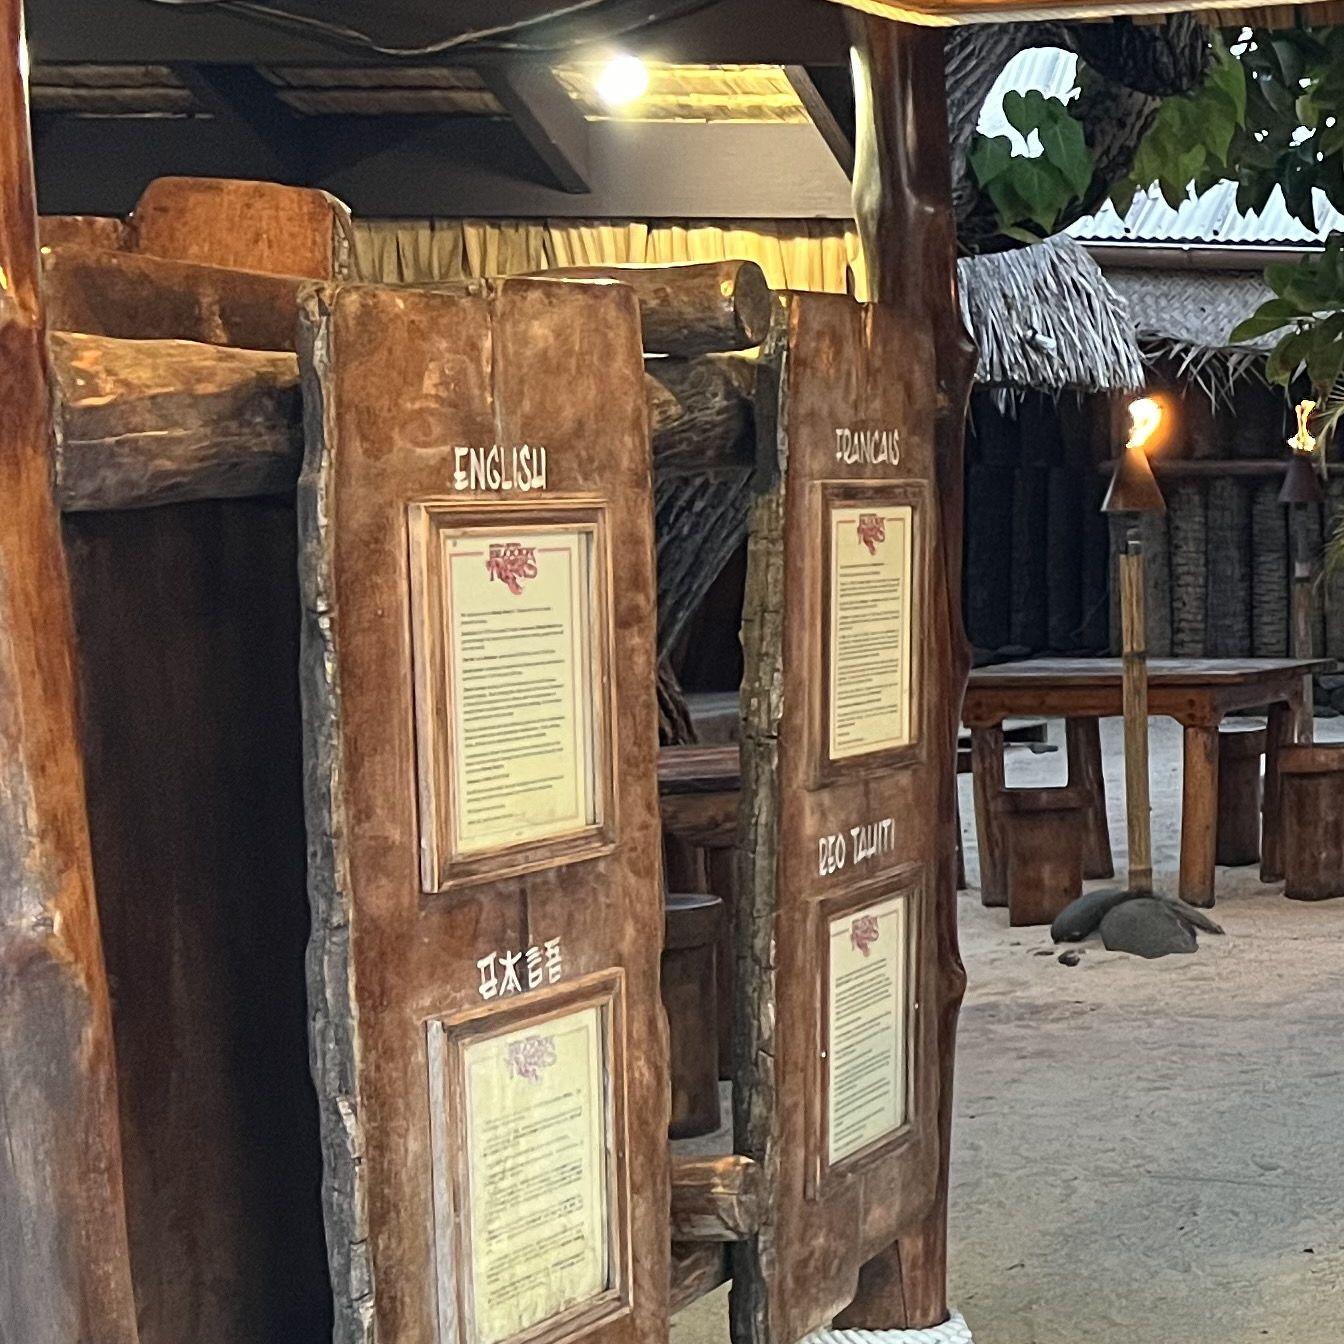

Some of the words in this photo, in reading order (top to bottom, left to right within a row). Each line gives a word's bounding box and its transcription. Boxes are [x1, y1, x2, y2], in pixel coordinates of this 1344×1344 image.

[453, 444, 546, 491] ENGLISH
[819, 832, 846, 876] REO
[850, 818, 895, 865] TAHITI
[477, 936, 562, 1000] 日本語
